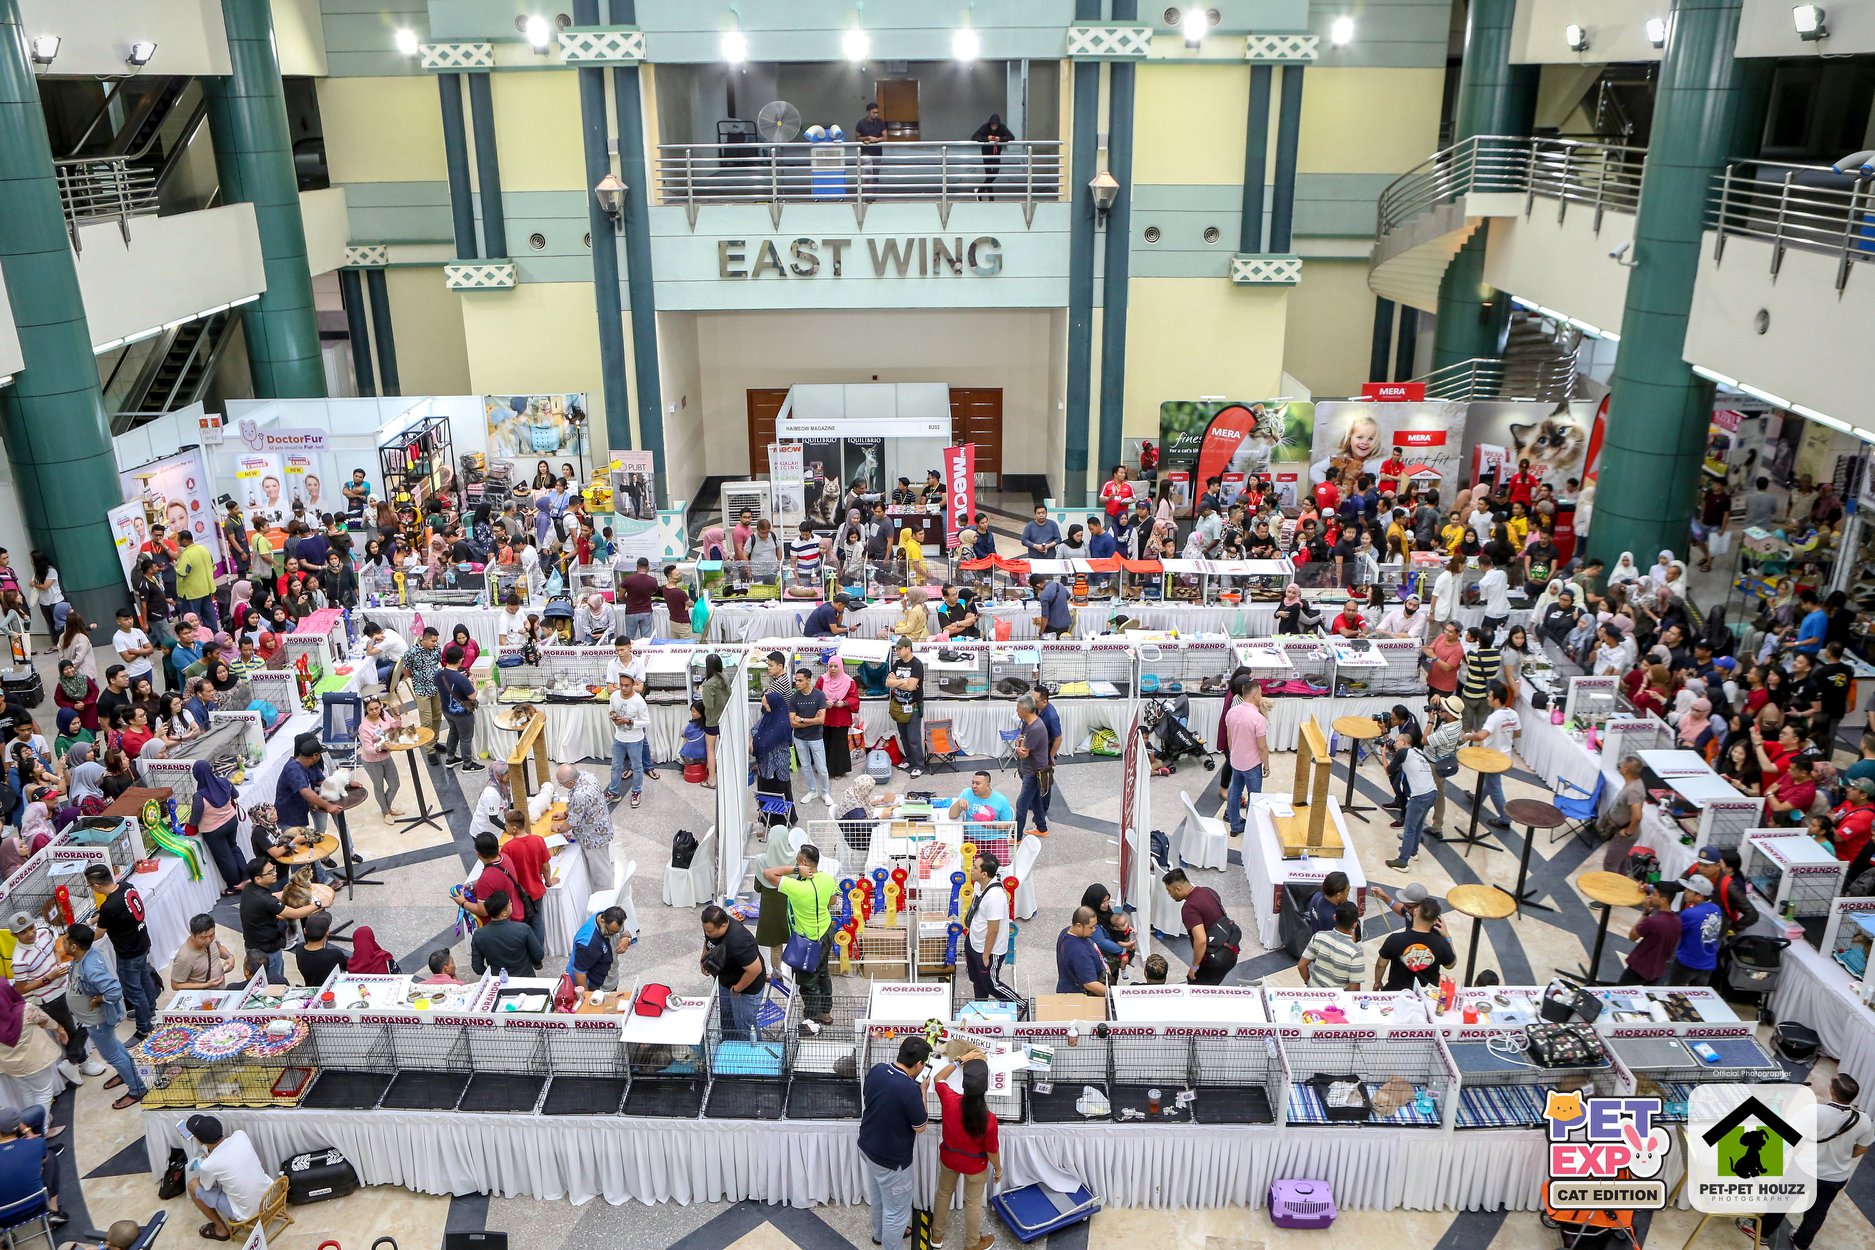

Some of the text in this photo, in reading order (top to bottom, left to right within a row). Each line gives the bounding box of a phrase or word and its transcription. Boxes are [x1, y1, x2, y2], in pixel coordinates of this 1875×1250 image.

[717, 236, 1004, 278] EAST WING
[1379, 387, 1406, 395] MERA
[1211, 427, 1241, 439] MERA
[266, 434, 323, 444] DoctorFur
[1407, 434, 1431, 442] MERA
[1400, 455, 1429, 466] nest
[628, 463, 647, 471] PUBT
[1574, 680, 1614, 688] MORANDO
[1611, 723, 1654, 731] MORANDO
[148, 763, 192, 771] MORANDO
[55, 851, 103, 859] MORANDO
[9, 858, 42, 890] MORANDO
[1789, 866, 1841, 875] MORANDO
[1121, 988, 1251, 996] MORANDO MORANDO
[1276, 990, 1336, 998] MORANDO
[164, 1016, 224, 1024] MORANDO
[361, 1016, 421, 1025] MORANDO
[435, 1016, 494, 1026] MORANDO
[506, 1019, 617, 1030] MORANDO RANDO
[1014, 1027, 1068, 1036] MORAND
[1166, 1027, 1228, 1036] MORANDO
[1313, 1030, 1376, 1039] MORANDO
[1389, 1030, 1451, 1038] MORANO
[1614, 1028, 1748, 1037] MORANDO MORANDO
